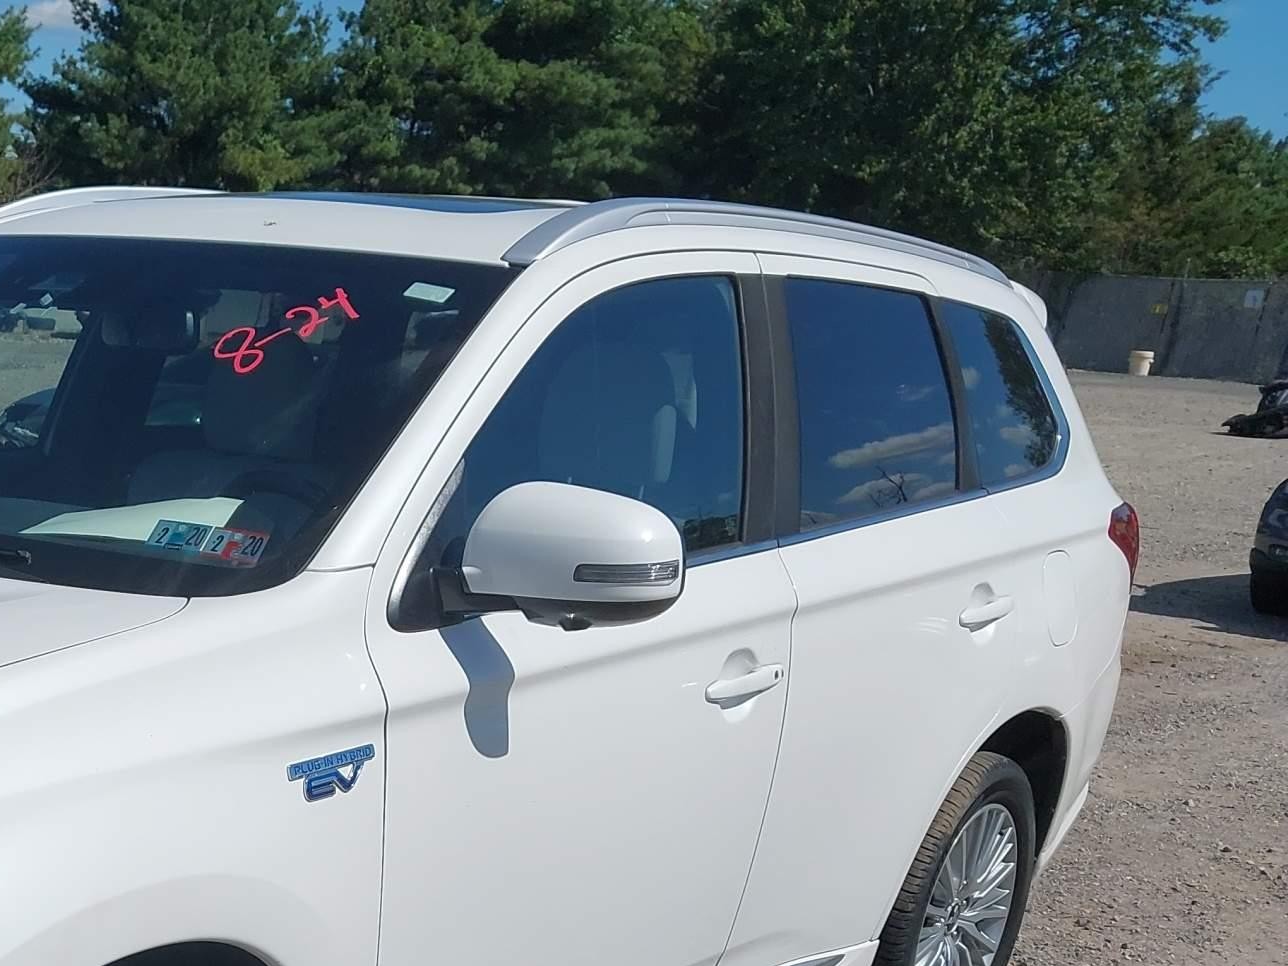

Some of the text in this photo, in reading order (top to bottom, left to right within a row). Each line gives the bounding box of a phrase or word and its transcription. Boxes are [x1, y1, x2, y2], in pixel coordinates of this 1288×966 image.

[213, 287, 361, 375] 8-24
[185, 527, 208, 546] 20
[242, 536, 264, 556] 20
[336, 747, 372, 765] HYBRID
[303, 761, 365, 803] EV
